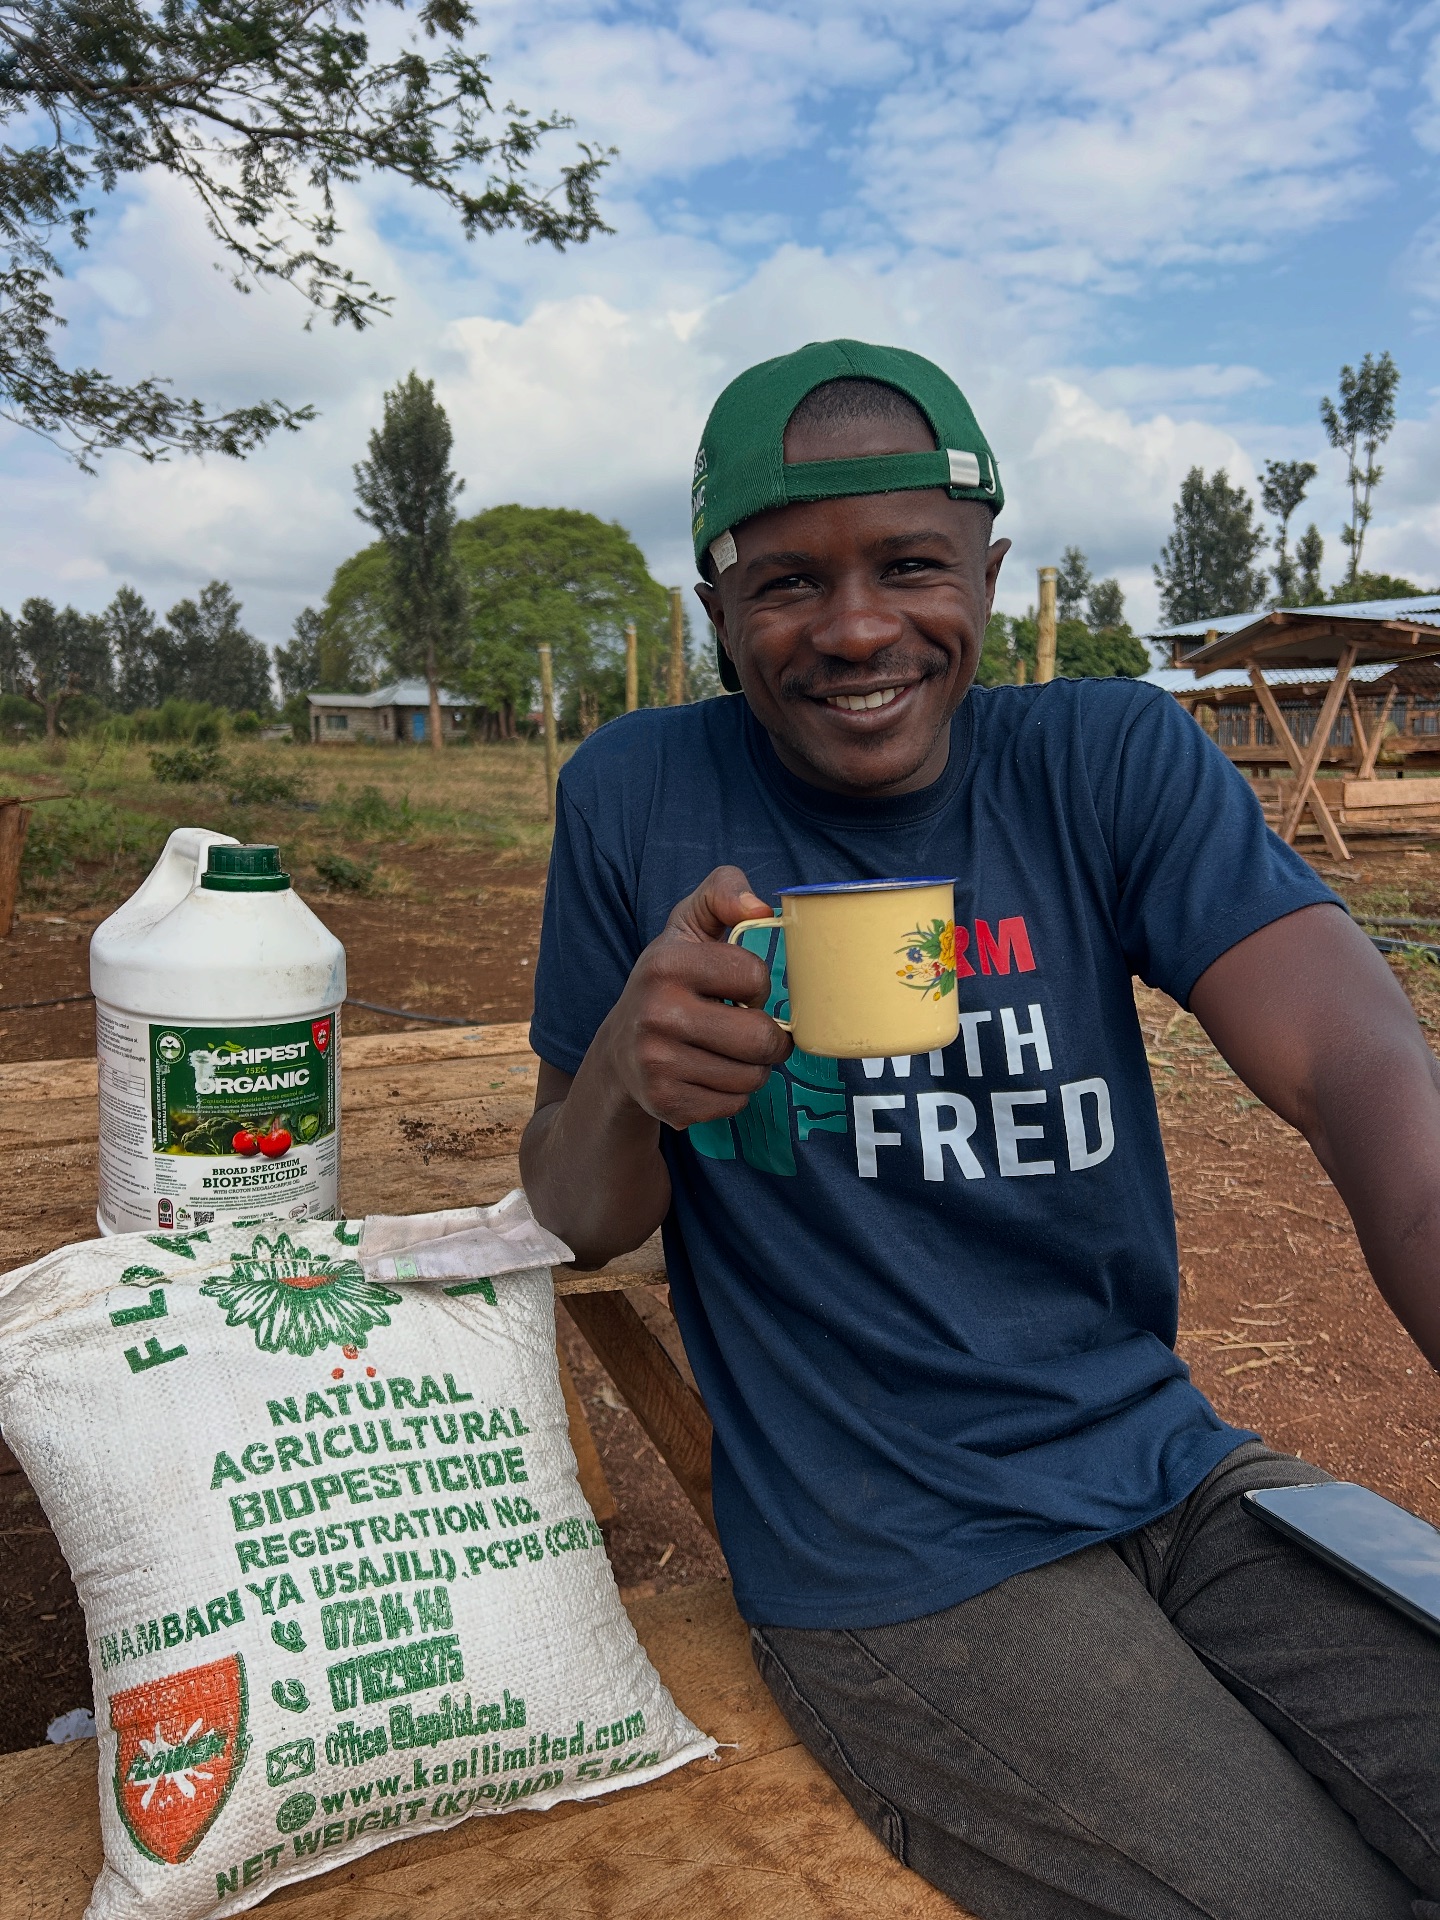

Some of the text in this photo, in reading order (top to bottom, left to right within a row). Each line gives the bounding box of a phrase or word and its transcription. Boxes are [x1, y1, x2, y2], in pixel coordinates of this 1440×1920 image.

[195, 1069, 310, 1095] ORGANIC
[245, 1066, 268, 1075] 75EC
[853, 1077, 1115, 1182] FRED
[202, 1165, 308, 1188] BIOPESTICIDE
[212, 1158, 300, 1176] BROAD SPECTRUM
[266, 1373, 474, 1426] NATURAL
[210, 1407, 531, 1490] AGRICULTURAL
[229, 1446, 529, 1532] BIOPESTICIDE
[234, 1496, 541, 1574] REGISTRATION NO.
[245, 1573, 305, 1615] YA
[215, 1843, 285, 1899] NET
[292, 1797, 428, 1858] WEIGHT
